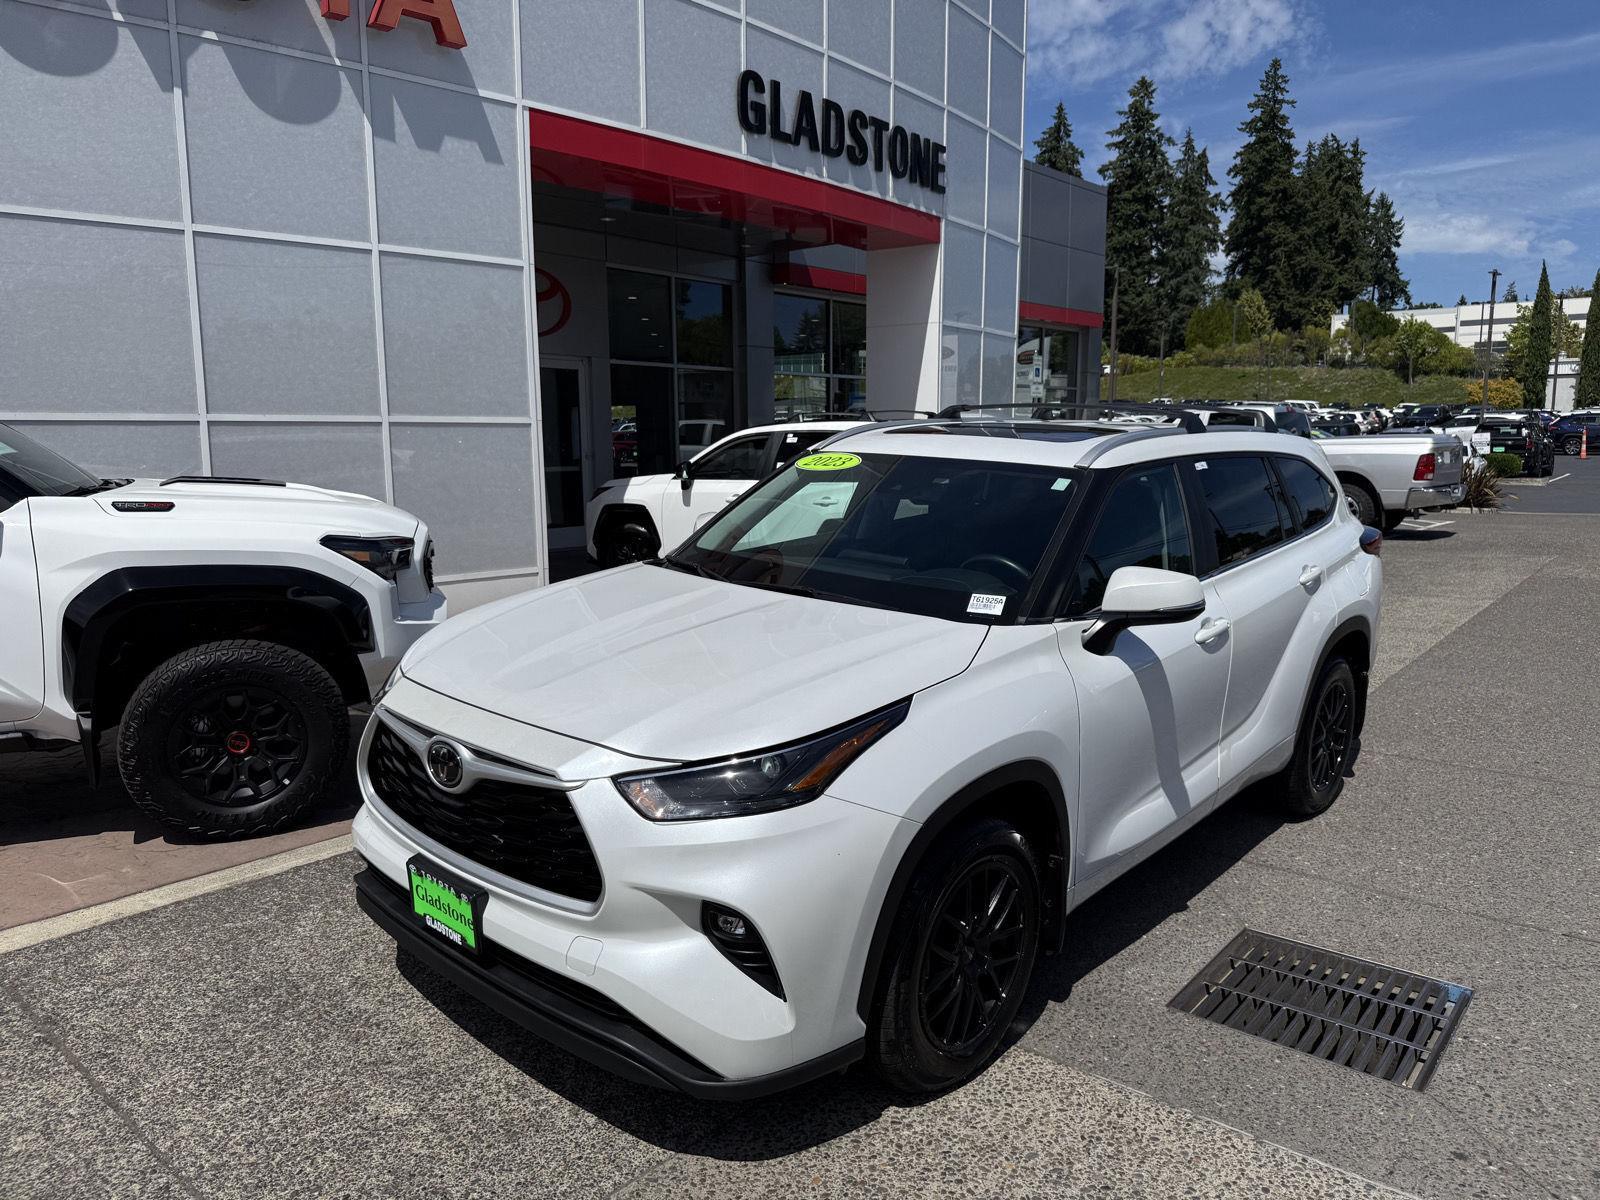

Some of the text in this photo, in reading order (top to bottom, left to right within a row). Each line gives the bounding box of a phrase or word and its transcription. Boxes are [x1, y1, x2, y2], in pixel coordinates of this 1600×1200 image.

[738, 69, 947, 194] GLADSTONE
[803, 456, 854, 467] 2023
[420, 870, 456, 895] TOYOTA
[415, 884, 474, 930] Gladstone
[426, 915, 462, 945] GLADSTONE
